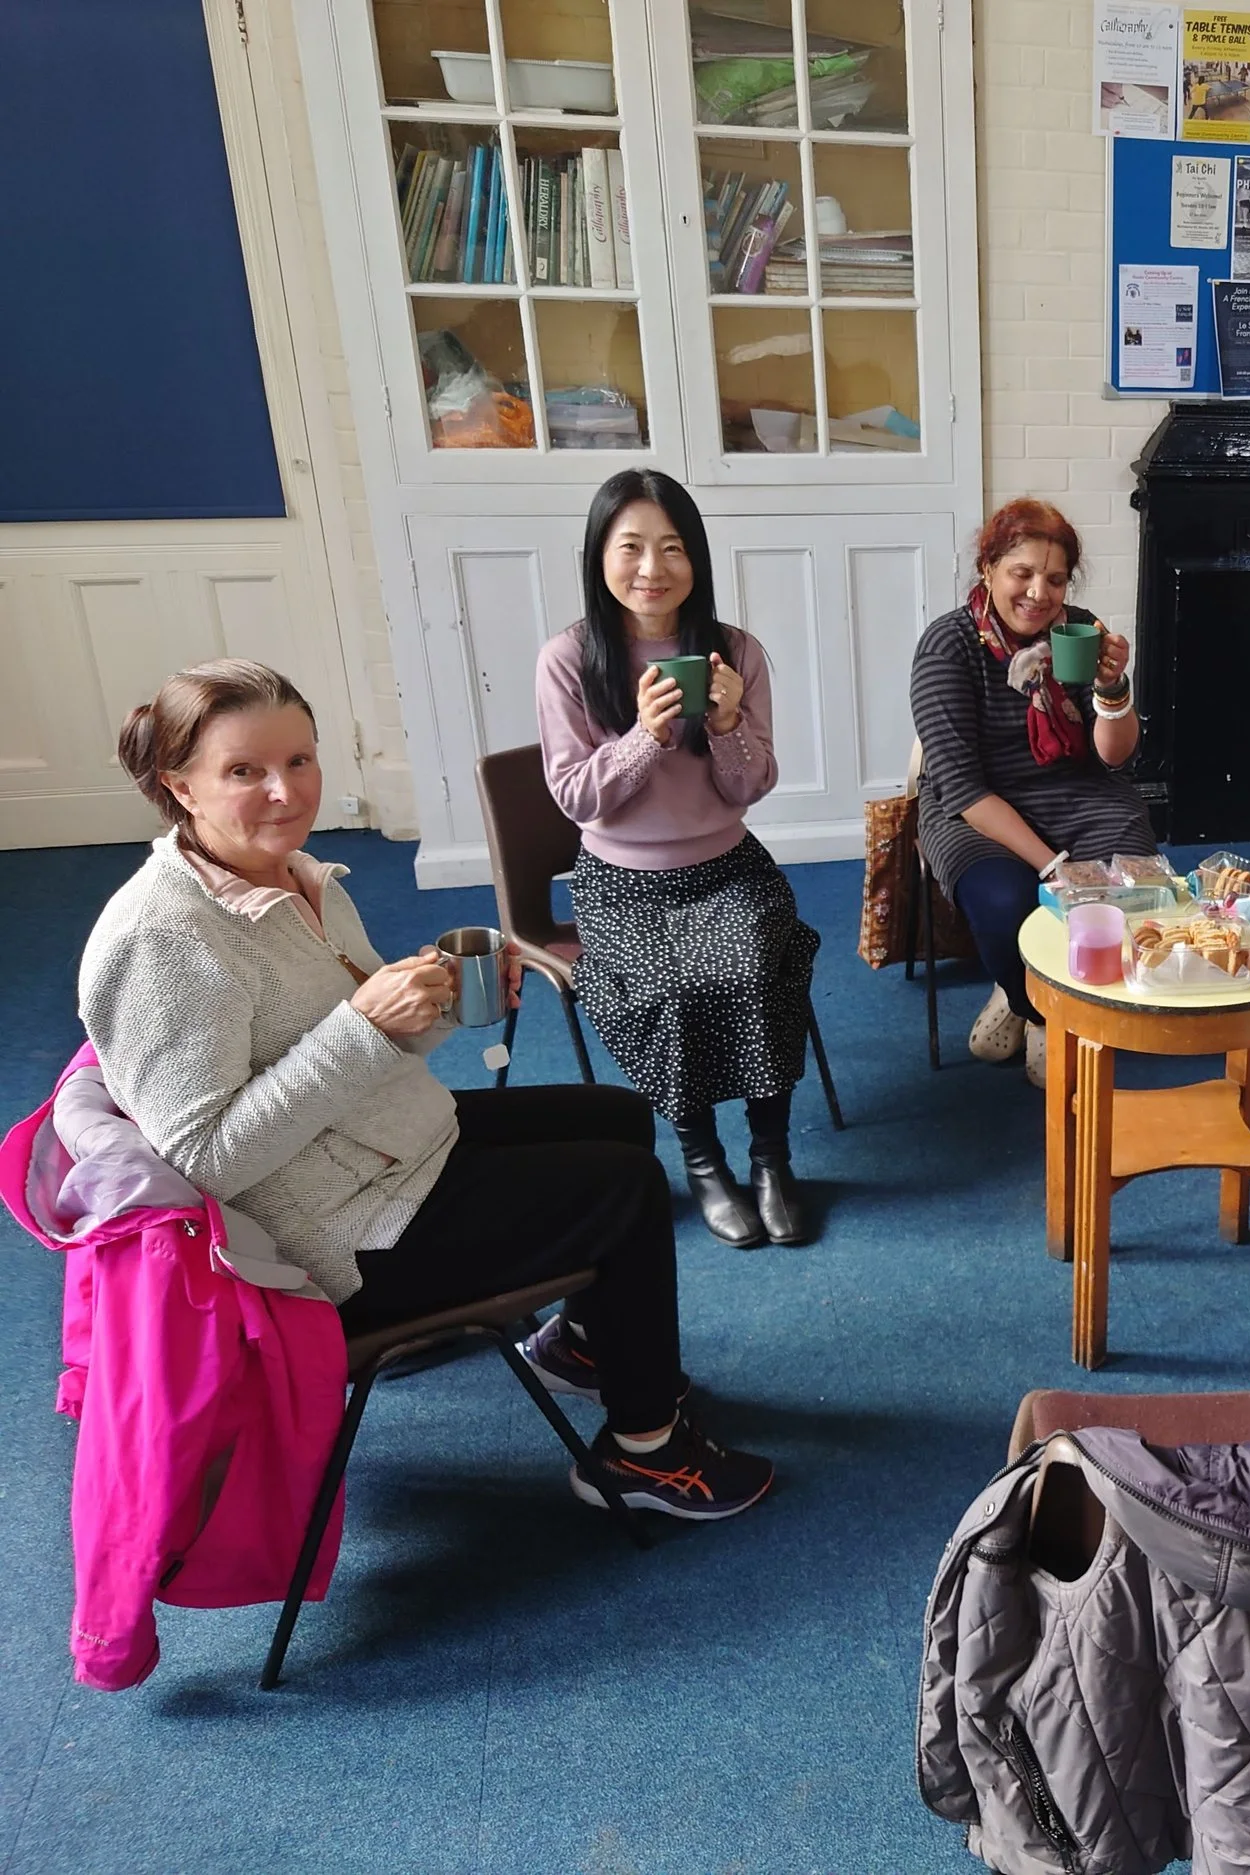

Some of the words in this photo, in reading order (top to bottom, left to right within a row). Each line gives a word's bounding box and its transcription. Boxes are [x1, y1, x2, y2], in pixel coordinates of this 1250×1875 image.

[1100, 17, 1148, 33] Calligraphy
[1186, 21, 1217, 32] TABLE
[1192, 33, 1198, 42] &
[1201, 34, 1227, 44] PICKLE
[1229, 36, 1246, 44] BALL
[1185, 163, 1199, 174] Tai
[1201, 163, 1217, 175] Chi
[538, 178, 549, 230] HERALDRY
[1233, 287, 1248, 295] Join
[1238, 321, 1247, 329] Le
